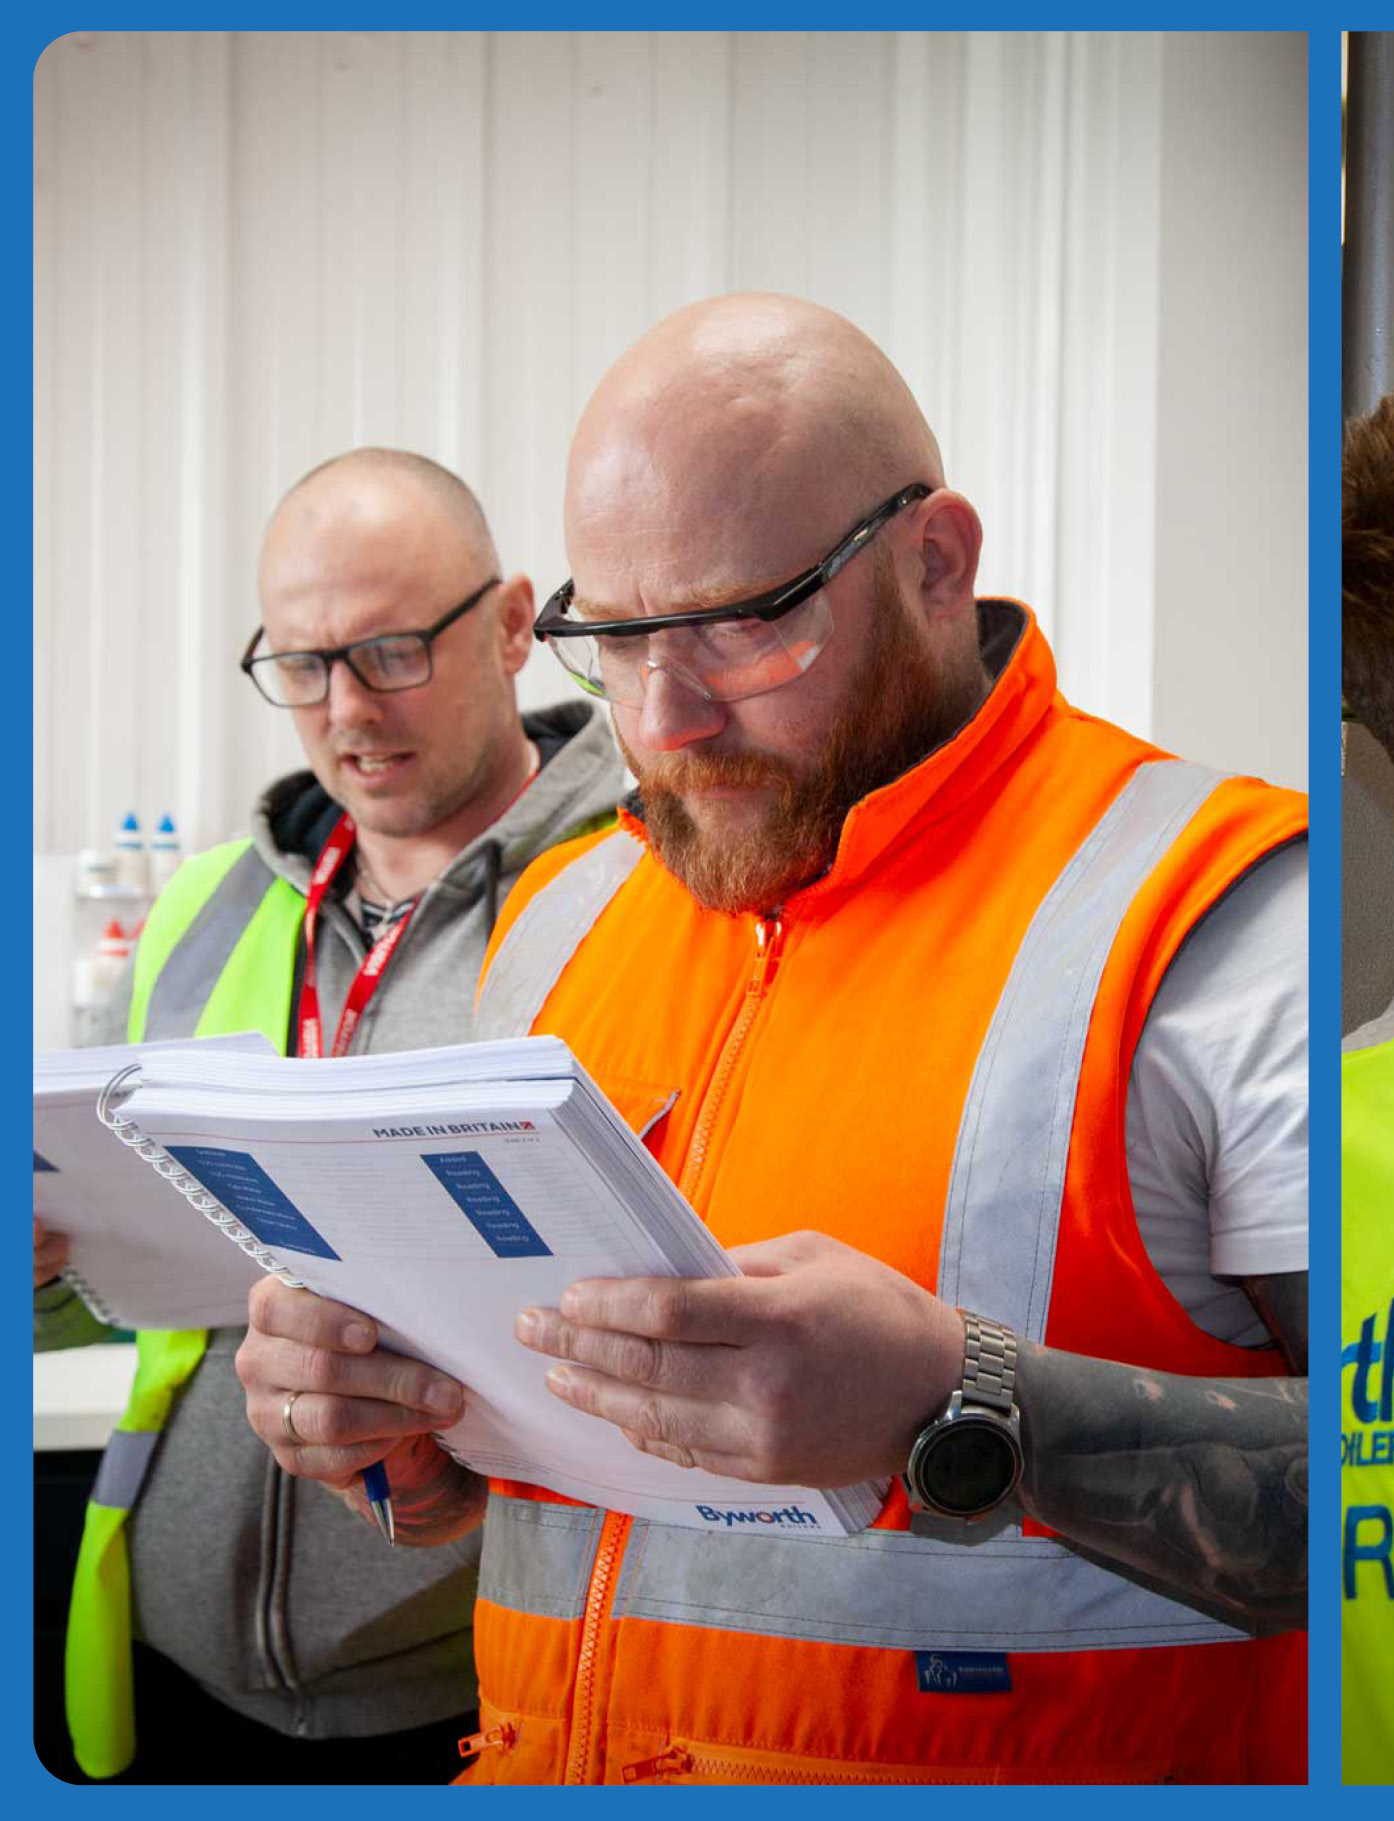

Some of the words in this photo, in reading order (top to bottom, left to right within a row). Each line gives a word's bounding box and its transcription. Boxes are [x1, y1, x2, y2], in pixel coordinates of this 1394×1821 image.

[372, 1125, 426, 1138] MADE
[428, 1125, 447, 1136] IN
[449, 1121, 520, 1134] BRITAIN
[695, 1504, 818, 1527] Byworth
